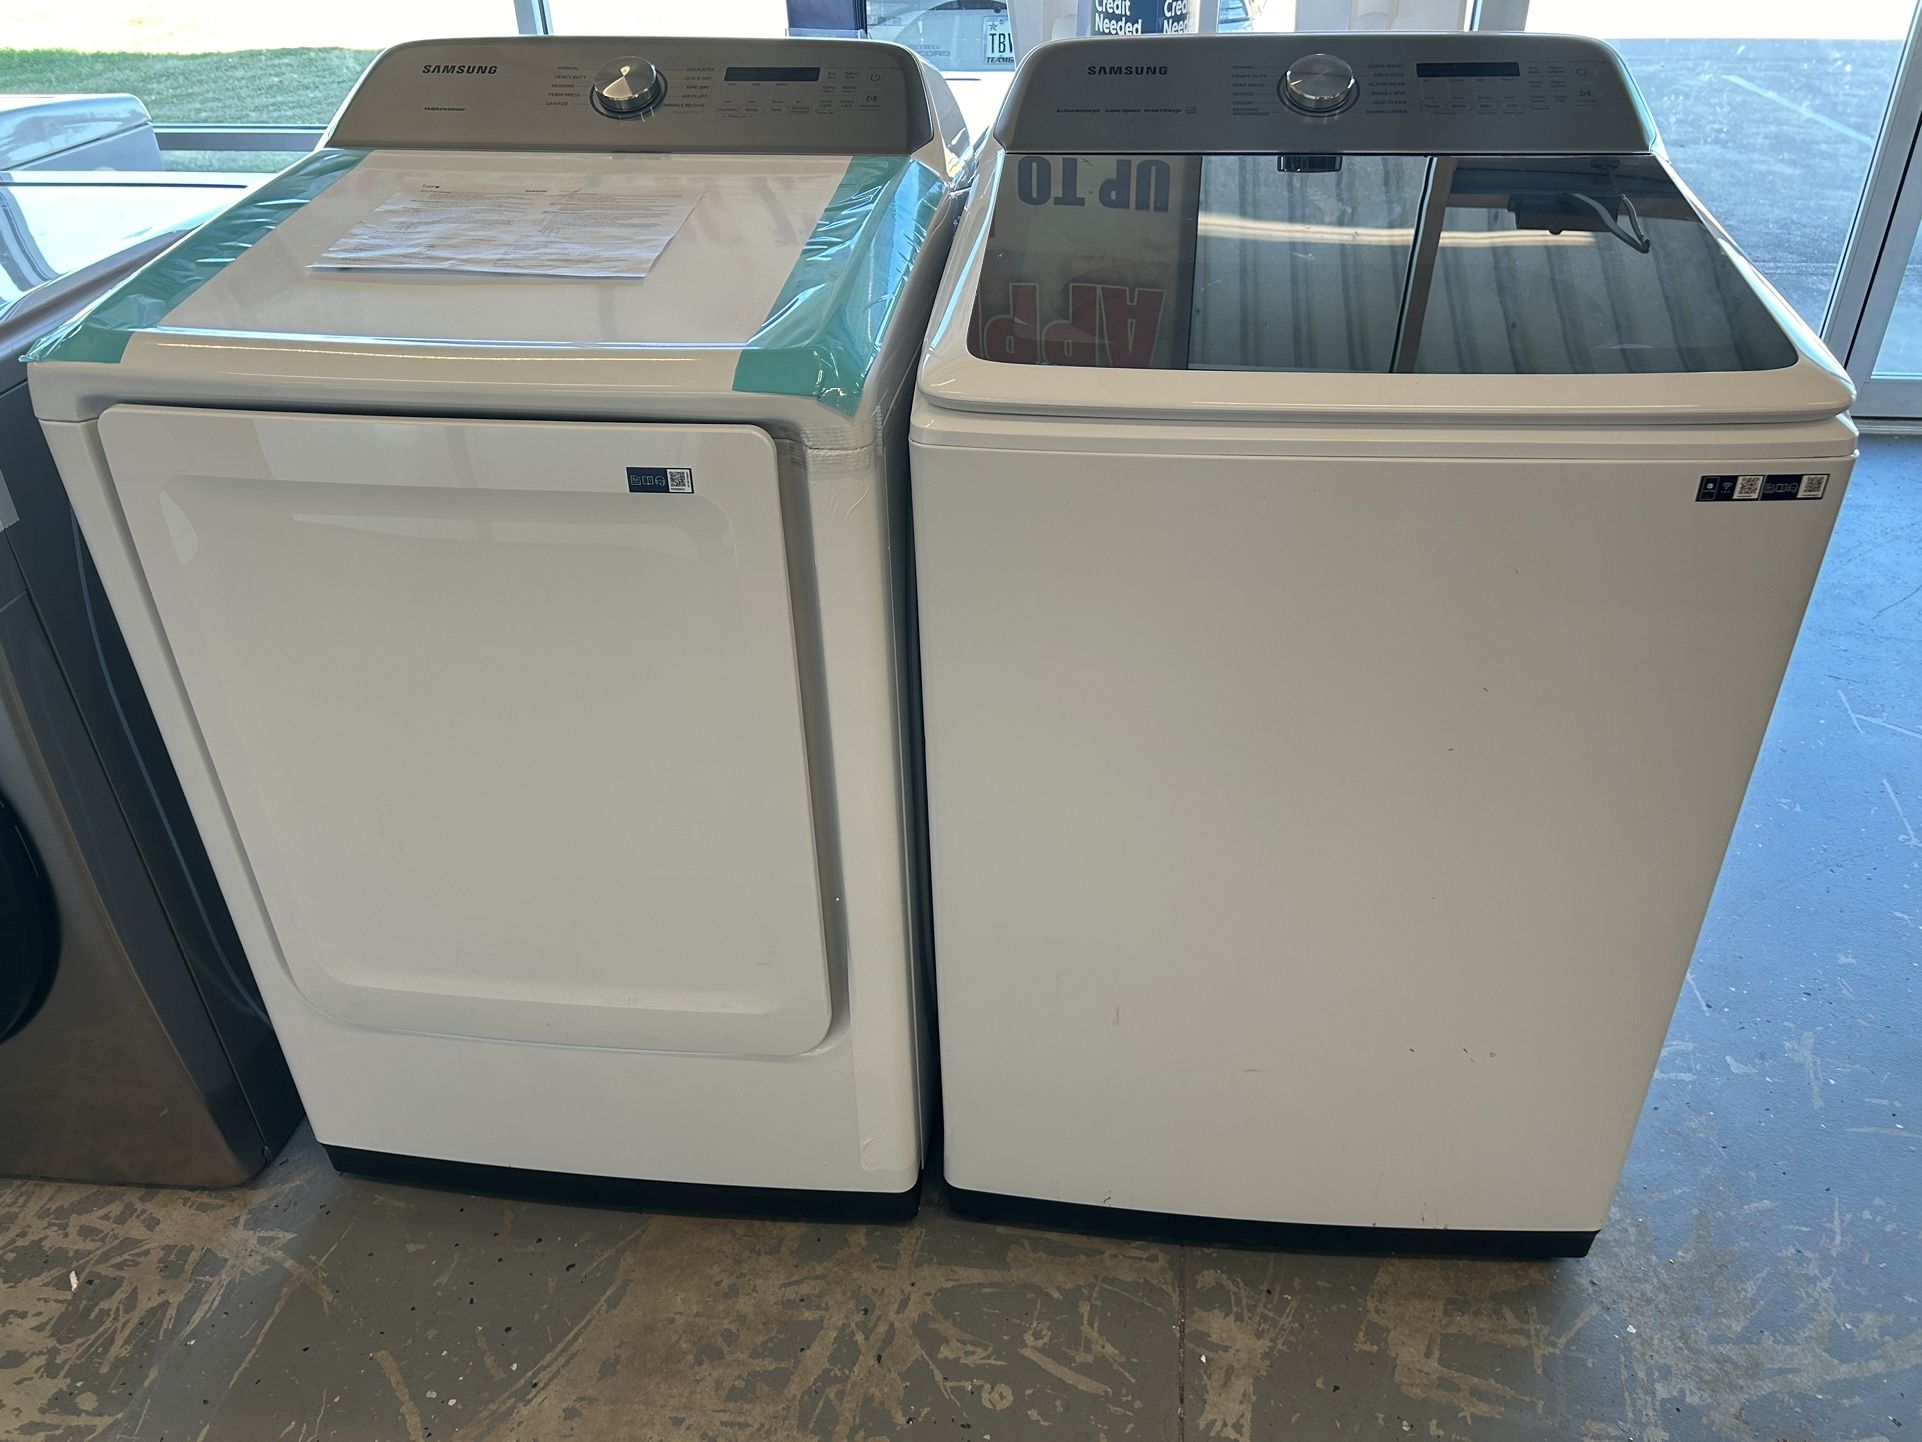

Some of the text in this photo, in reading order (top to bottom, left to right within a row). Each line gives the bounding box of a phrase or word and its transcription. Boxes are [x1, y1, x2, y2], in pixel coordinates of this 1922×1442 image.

[1095, 0, 1130, 16] Credit
[1095, 13, 1142, 35] Needed
[422, 64, 498, 74] SAMSUNG
[1087, 65, 1168, 75] SAMSUNG
[1017, 155, 1170, 213] UP TO
[968, 283, 1166, 368] APP
